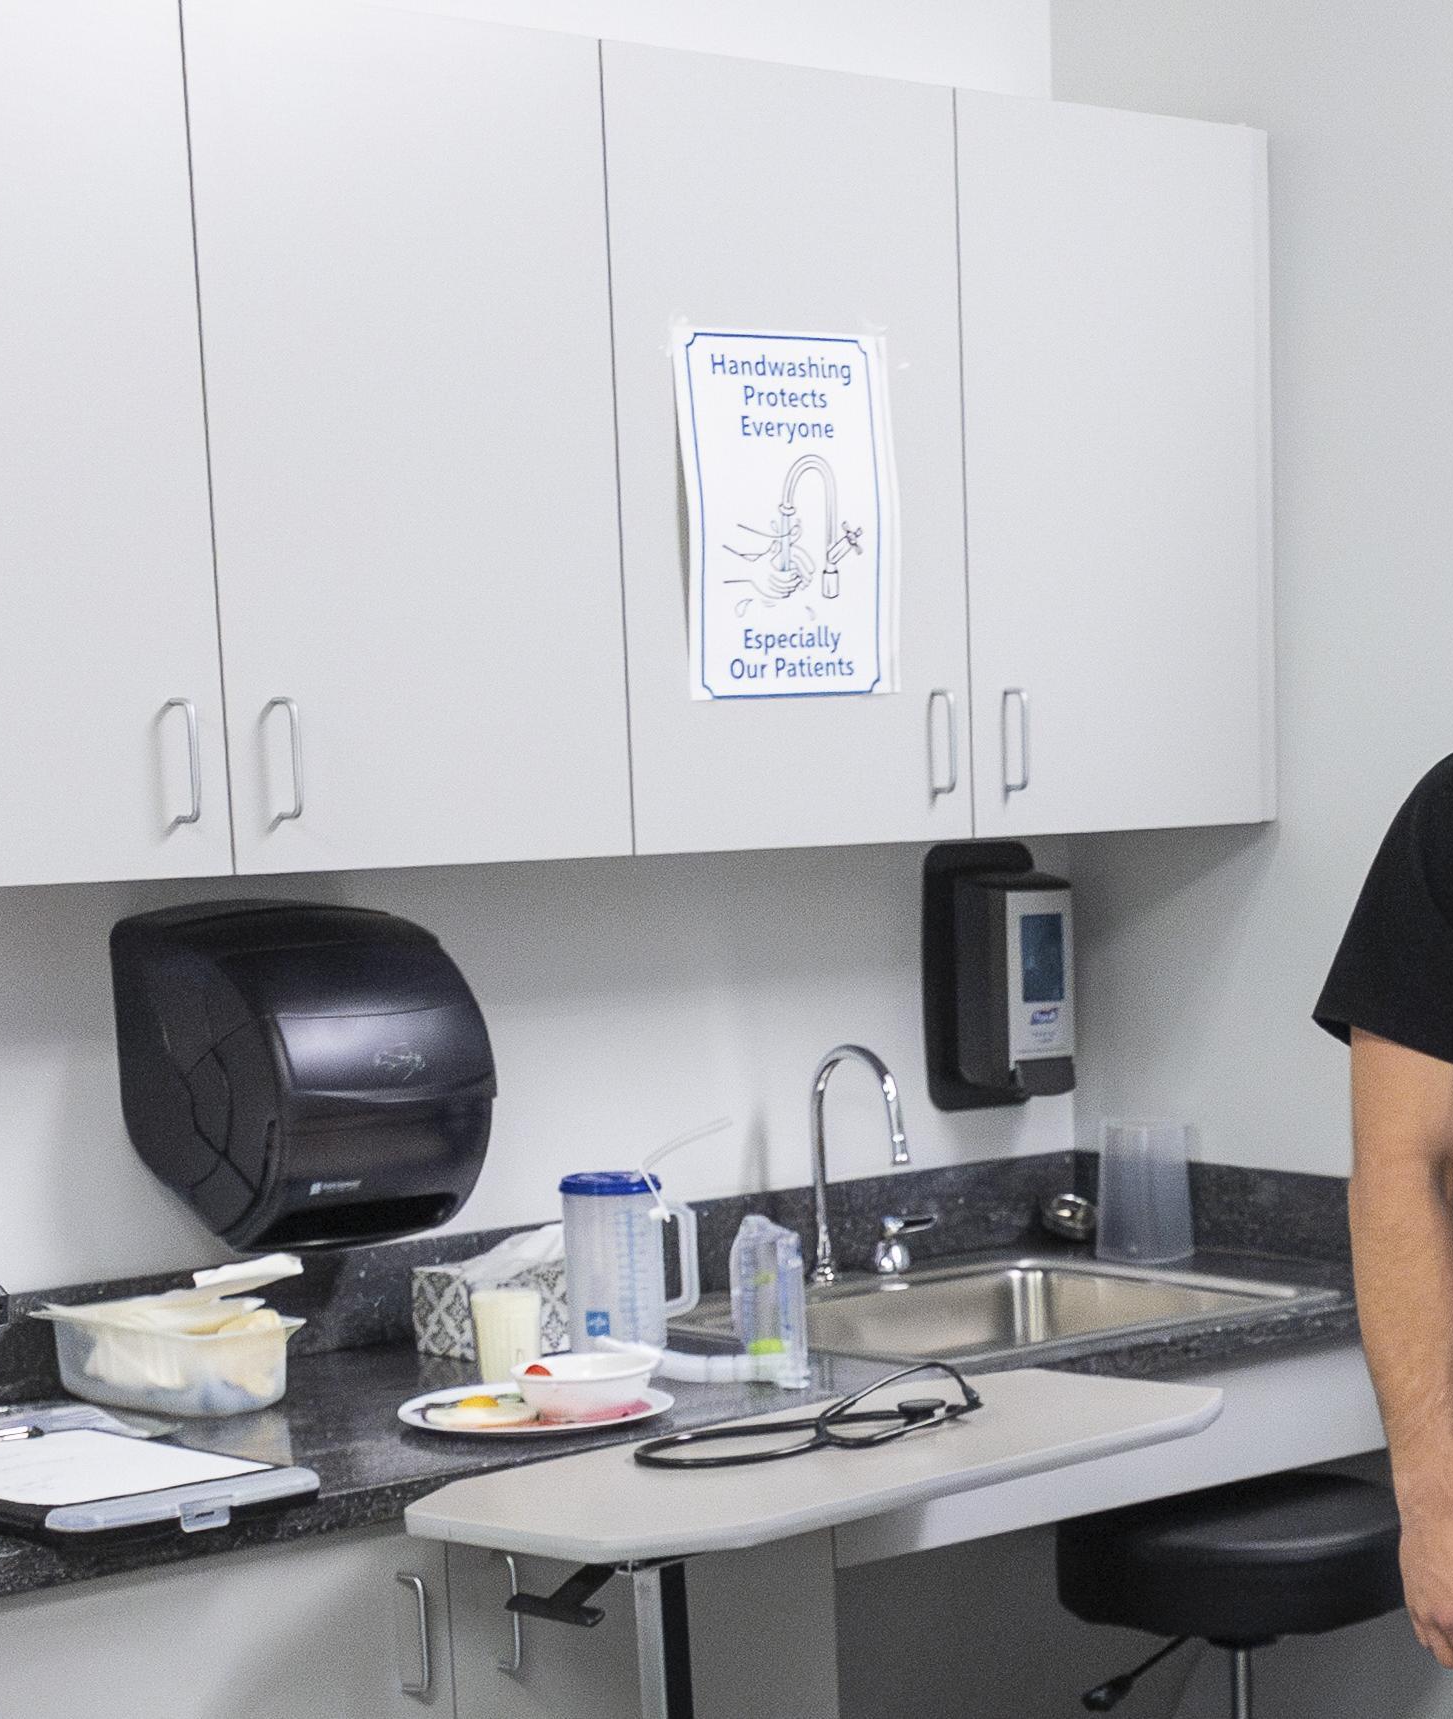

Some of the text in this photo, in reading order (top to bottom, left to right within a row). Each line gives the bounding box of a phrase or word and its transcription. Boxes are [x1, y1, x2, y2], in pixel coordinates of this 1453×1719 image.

[710, 354, 852, 386] Handwashing
[743, 385, 828, 408] Protects
[740, 416, 835, 444] Everyone
[743, 625, 842, 655] Especially
[729, 656, 855, 680] Our Patients
